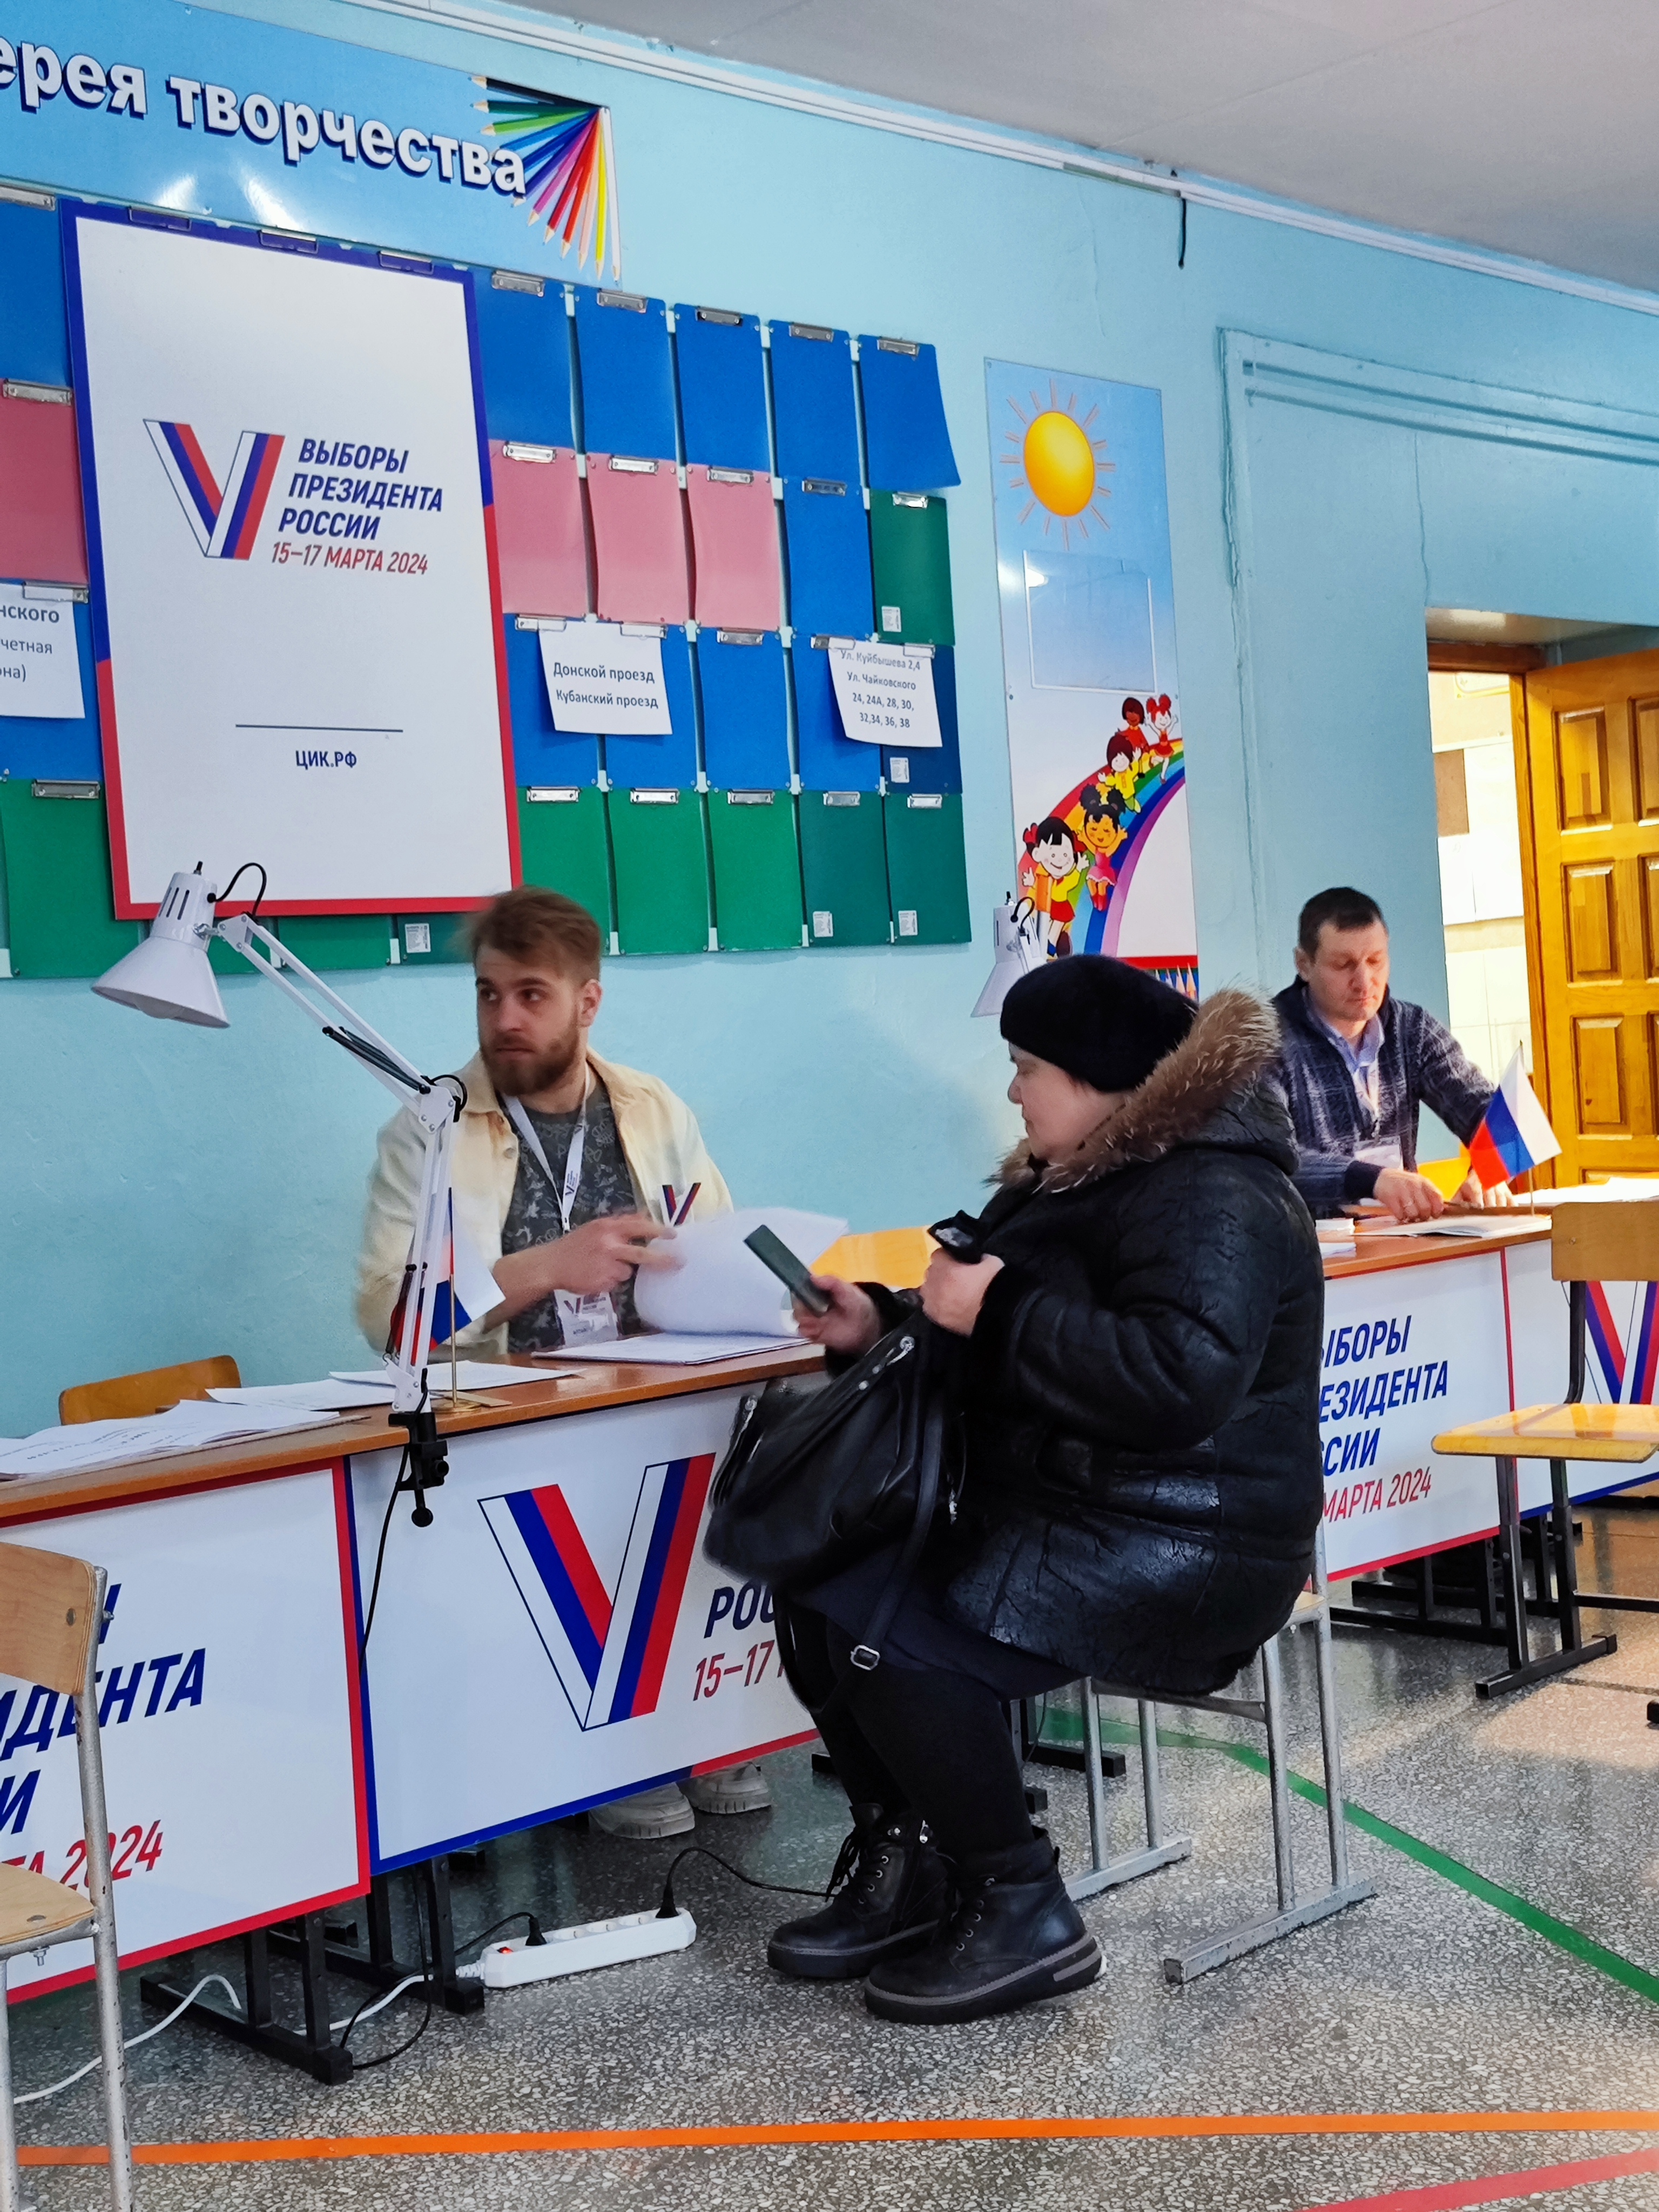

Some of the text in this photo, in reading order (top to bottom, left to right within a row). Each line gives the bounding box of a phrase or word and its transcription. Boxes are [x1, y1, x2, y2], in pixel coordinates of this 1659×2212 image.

[166, 75, 527, 196] творчества
[298, 438, 409, 474] ВЫБОРЫ
[288, 473, 443, 512] ПРЕЗИДЕНТА
[278, 508, 381, 540] РОССИИ
[323, 546, 384, 571] МАРТА
[386, 552, 428, 575] 2024
[1, 639, 52, 654] четная
[841, 650, 920, 671] Ул. Куйбышева 2,4
[0, 664, 26, 682] на)
[554, 662, 655, 683] Донской проезд
[847, 671, 916, 690] Ул. Чайковского
[556, 689, 658, 709] Кубанский проезд
[852, 692, 864, 704] 24,
[901, 699, 914, 711] 30,
[900, 718, 910, 728] 38
[295, 751, 356, 770] ЦИК.РФ
[1320, 1428, 1380, 1476] СИИ
[1387, 1466, 1431, 1508] 2024
